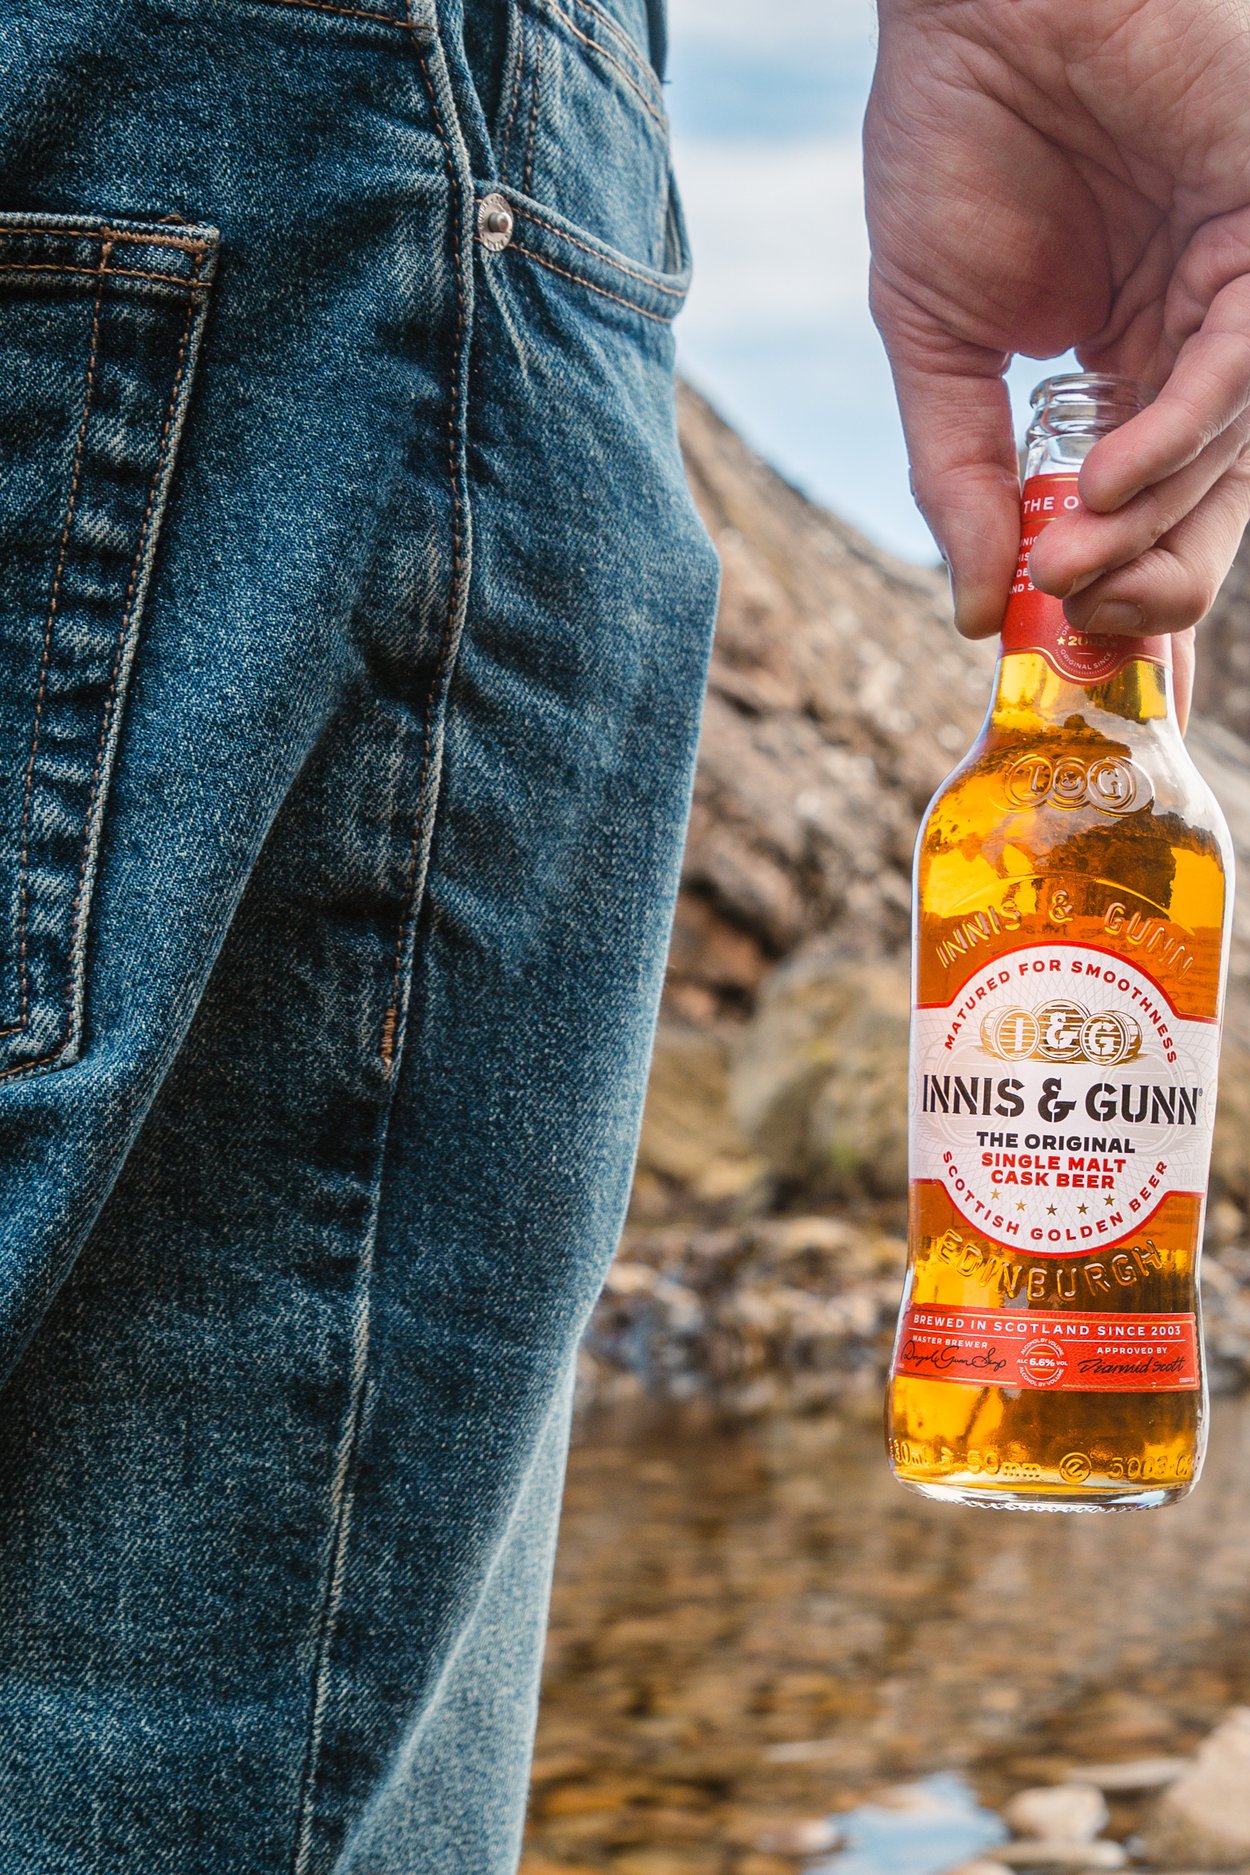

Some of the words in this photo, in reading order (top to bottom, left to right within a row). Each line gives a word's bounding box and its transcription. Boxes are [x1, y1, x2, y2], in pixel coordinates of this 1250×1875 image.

[1023, 496, 1055, 514] THE
[1060, 649, 1092, 670] ORIGINAL
[935, 897, 1022, 968] INNIS
[1049, 889, 1074, 924] &
[1103, 902, 1194, 980] GUNN
[944, 971, 1011, 1050] MATURED
[1018, 959, 1062, 976] FOR
[1071, 961, 1177, 1063] SMOOTHNESS
[922, 1074, 1025, 1118] INNIS
[1037, 1078, 1077, 1123] &
[1085, 1082, 1199, 1125] GUNN
[976, 1131, 1019, 1149] THE
[1024, 1134, 1136, 1154] ORIGINAL
[981, 1152, 1061, 1171] SINGLE
[1068, 1157, 1127, 1174] MALT
[990, 1169, 1050, 1187] CASK
[1056, 1173, 1115, 1190] BEER
[943, 1150, 1020, 1235] SCOTTISH
[1030, 1211, 1124, 1242] GOLDEN
[1128, 1160, 1168, 1213] BEER
[937, 1228, 1163, 1302] EDINBURGH
[913, 1314, 965, 1328] BREWED
[970, 1320, 987, 1330] IN
[993, 1321, 1090, 1335] SCOTLAND
[1097, 1325, 1146, 1336] SINCE
[1151, 1325, 1181, 1336] 2003
[912, 1335, 942, 1345] MASTER
[945, 1338, 988, 1349] BREWER
[1097, 1346, 1153, 1355] APPROVED
[1156, 1346, 1168, 1354] BY
[1029, 1358, 1055, 1367] 6.6%
